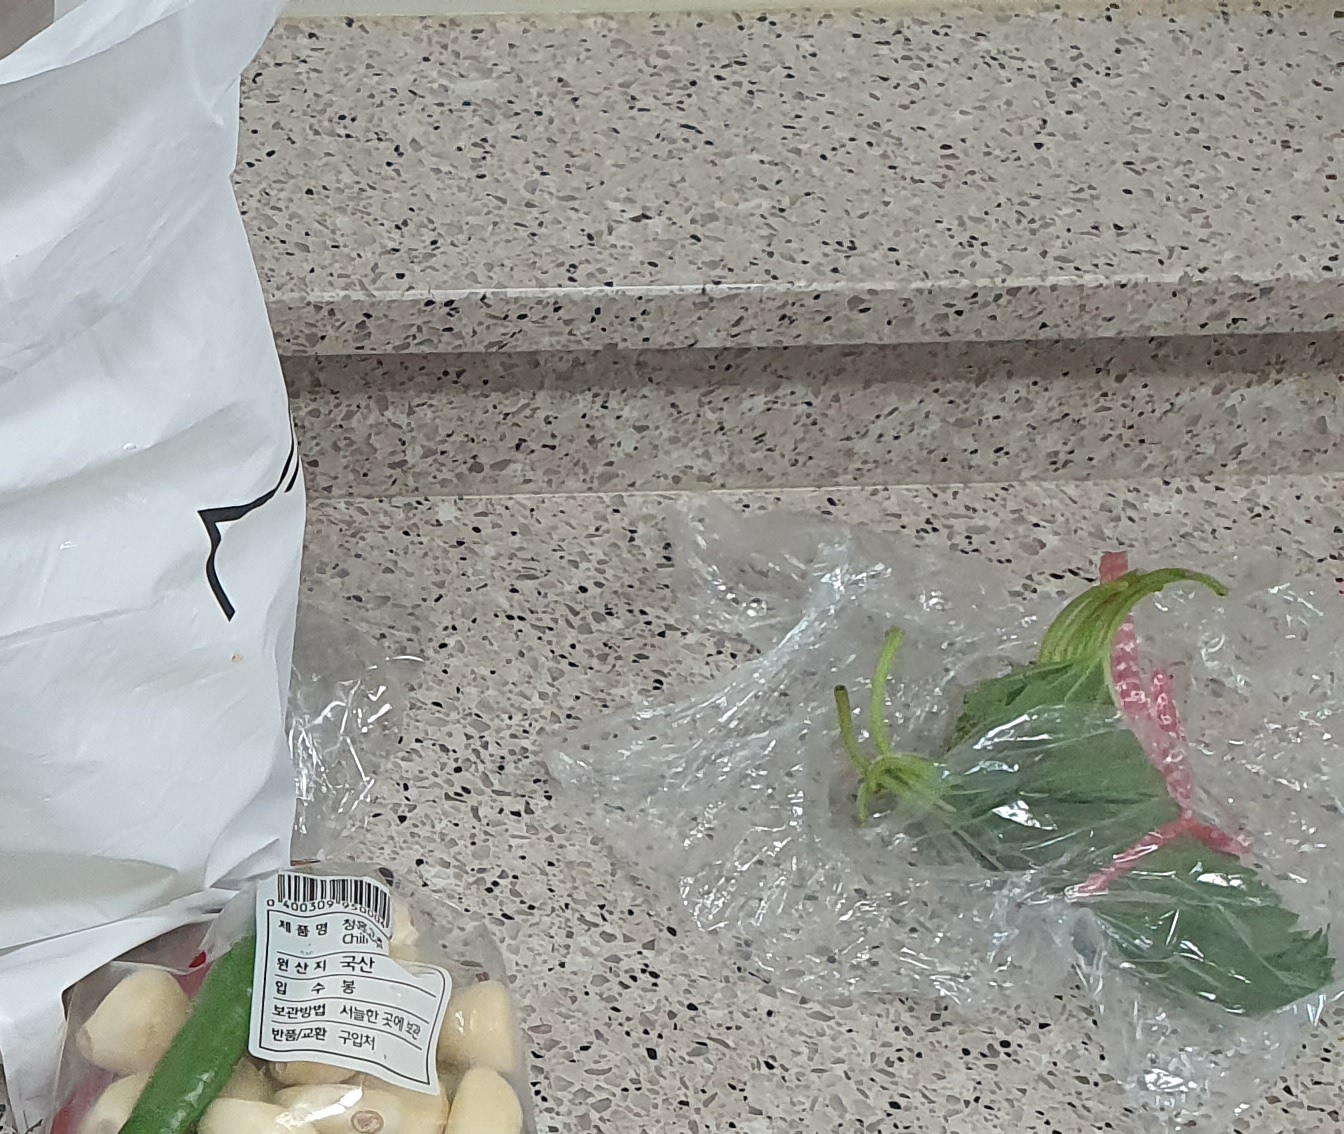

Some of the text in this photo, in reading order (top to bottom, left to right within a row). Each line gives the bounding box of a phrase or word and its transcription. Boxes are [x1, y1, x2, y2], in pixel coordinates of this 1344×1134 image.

[339, 955, 375, 974] 국산
[340, 979, 356, 995] 봉
[272, 1003, 422, 1041] 보관방법 서늘한 곳에 보관
[272, 1027, 376, 1051] 반품/교환 구입처
